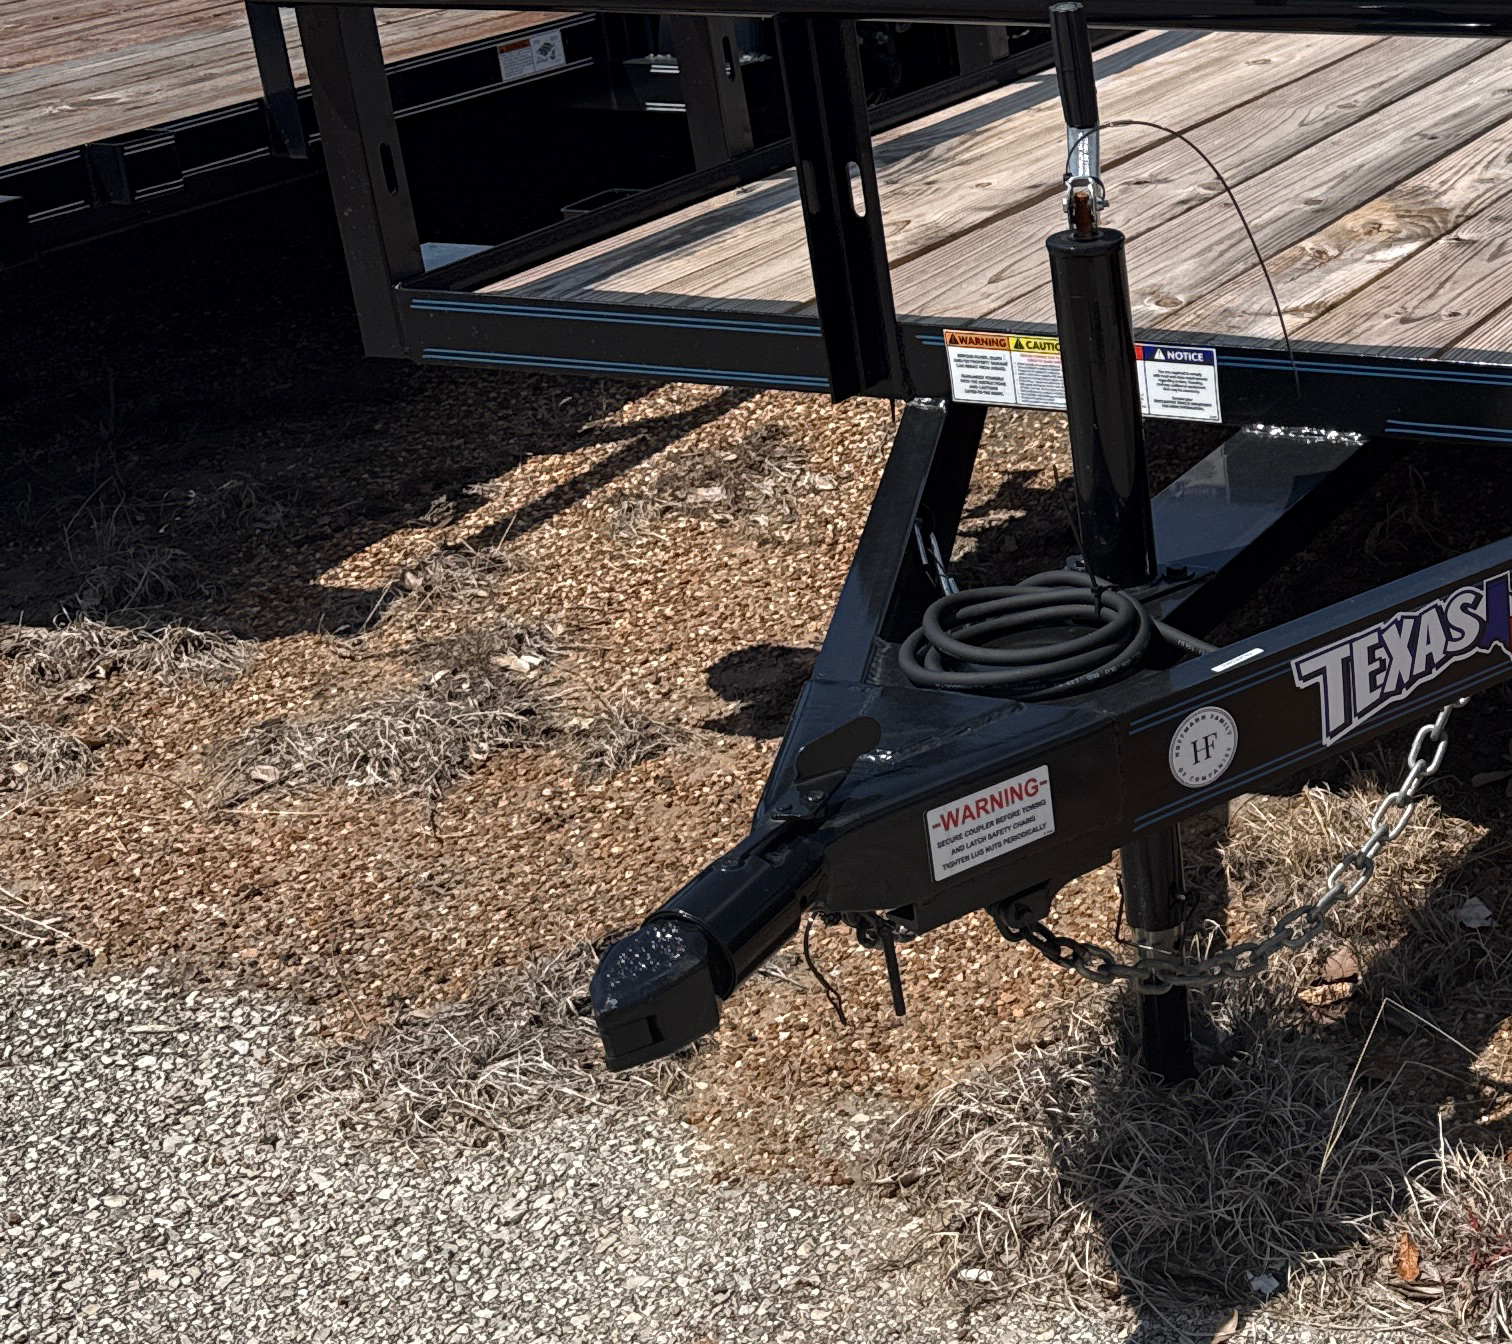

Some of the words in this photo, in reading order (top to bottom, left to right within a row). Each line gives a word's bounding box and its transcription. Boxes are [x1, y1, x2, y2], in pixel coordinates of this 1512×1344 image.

[957, 335, 1007, 348] WARNING
[1025, 340, 1061, 352] CAUTIO
[1166, 350, 1204, 362] NOTICE
[1296, 589, 1484, 738] TEXAS
[1209, 714, 1232, 736] FAMILY
[1191, 731, 1218, 765] HF
[937, 831, 963, 849] SECURE
[964, 820, 995, 838] COUPLER
[995, 809, 1021, 825] BEFORE
[951, 845, 965, 856] AND
[966, 835, 987, 850] LATCH
[988, 825, 1012, 840] SAFETY
[942, 853, 970, 871] TIGHTEN
[971, 846, 985, 859] LUG
[985, 839, 1002, 854] NUTS
[1003, 821, 1047, 846] PERIODICALLY
